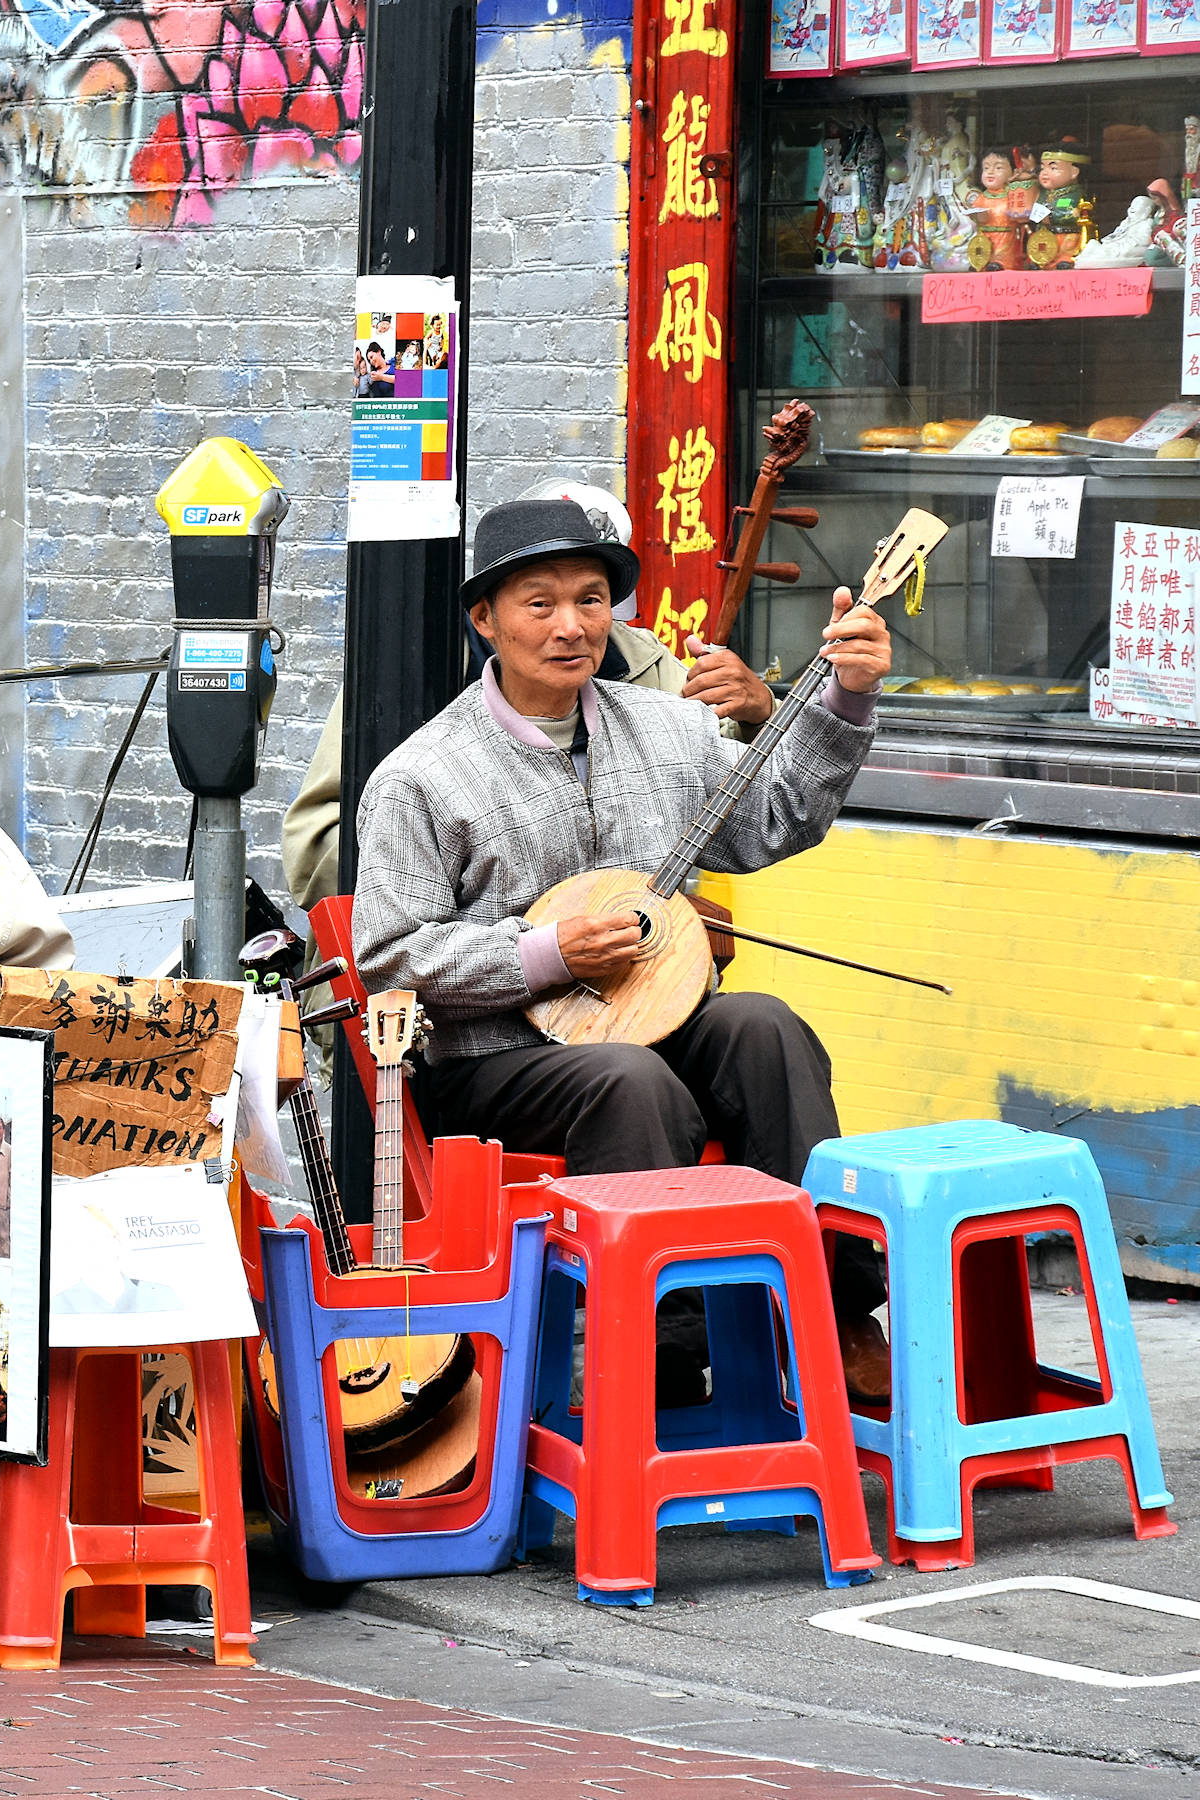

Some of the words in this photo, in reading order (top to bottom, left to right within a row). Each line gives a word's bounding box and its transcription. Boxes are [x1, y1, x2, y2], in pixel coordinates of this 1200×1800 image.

[1023, 278, 1051, 299] Down
[1116, 278, 1147, 298] Items
[1034, 478, 1047, 493] Pie
[1027, 498, 1051, 518] Apple
[1055, 497, 1069, 510] Pie
[1119, 526, 1200, 564] 東亞中秋
[182, 678, 227, 688] 36407430
[125, 1215, 154, 1229] TREY
[128, 1222, 201, 1240] ANASTASIO
